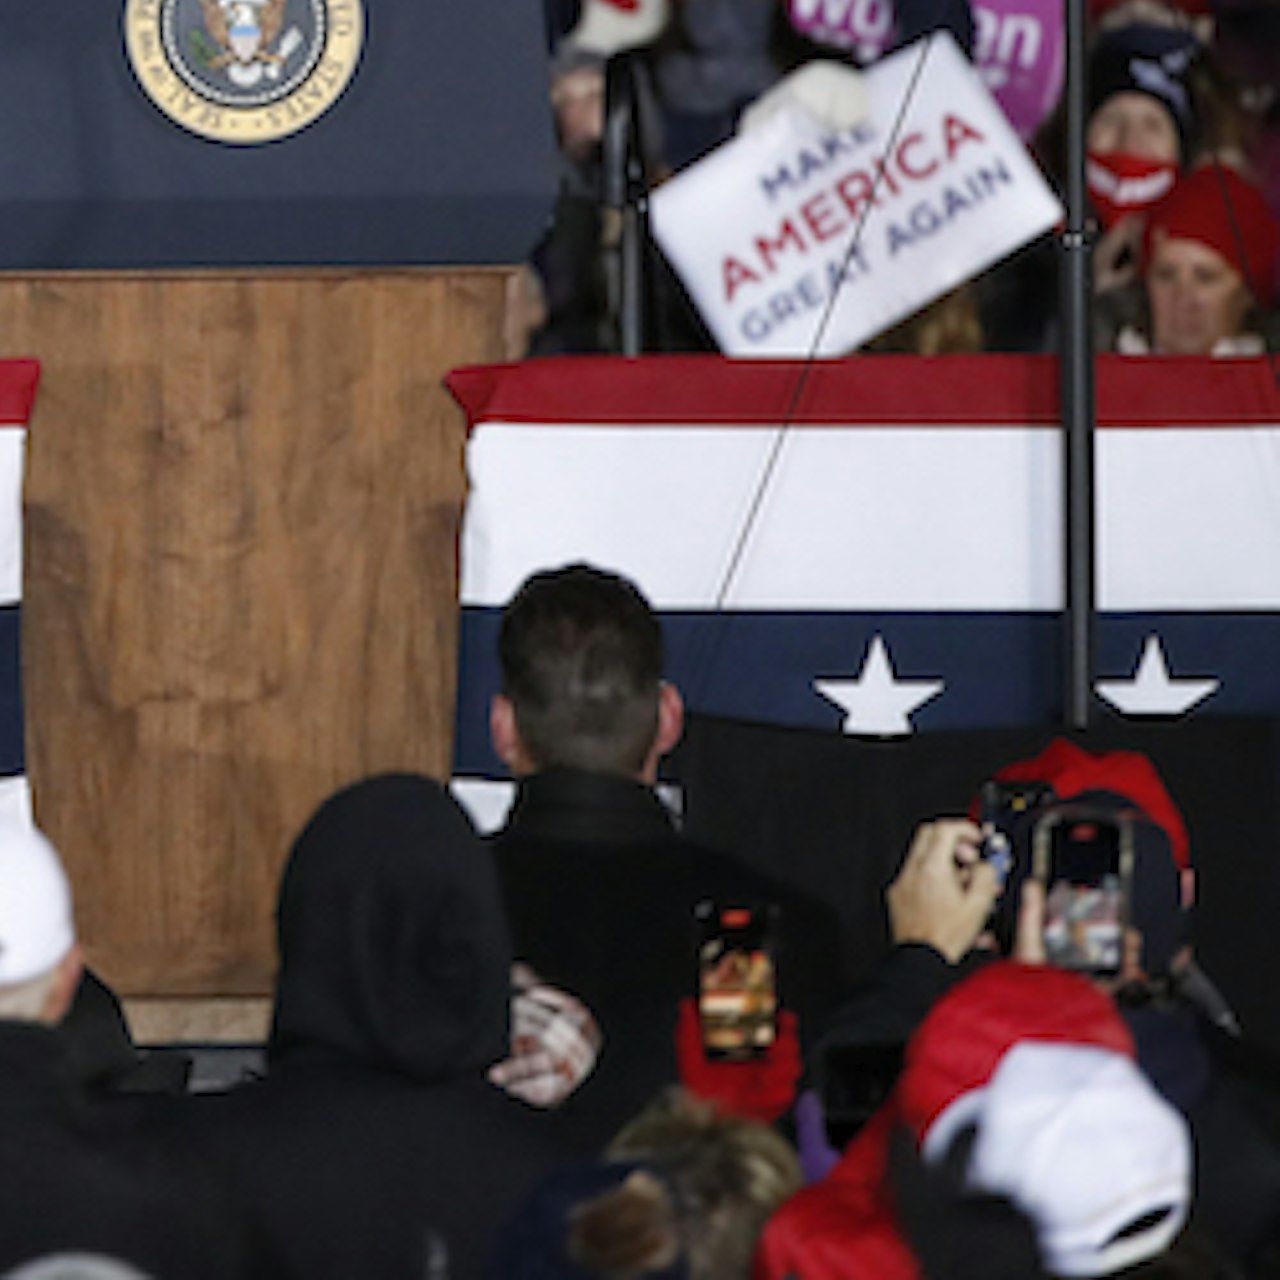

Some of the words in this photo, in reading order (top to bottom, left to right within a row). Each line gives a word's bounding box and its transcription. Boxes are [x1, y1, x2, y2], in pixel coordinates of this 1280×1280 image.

[720, 112, 986, 303] AMERICA
[741, 245, 871, 344] GREAT
[886, 158, 1014, 268] AGAIN
[759, 124, 878, 202] MAKE
